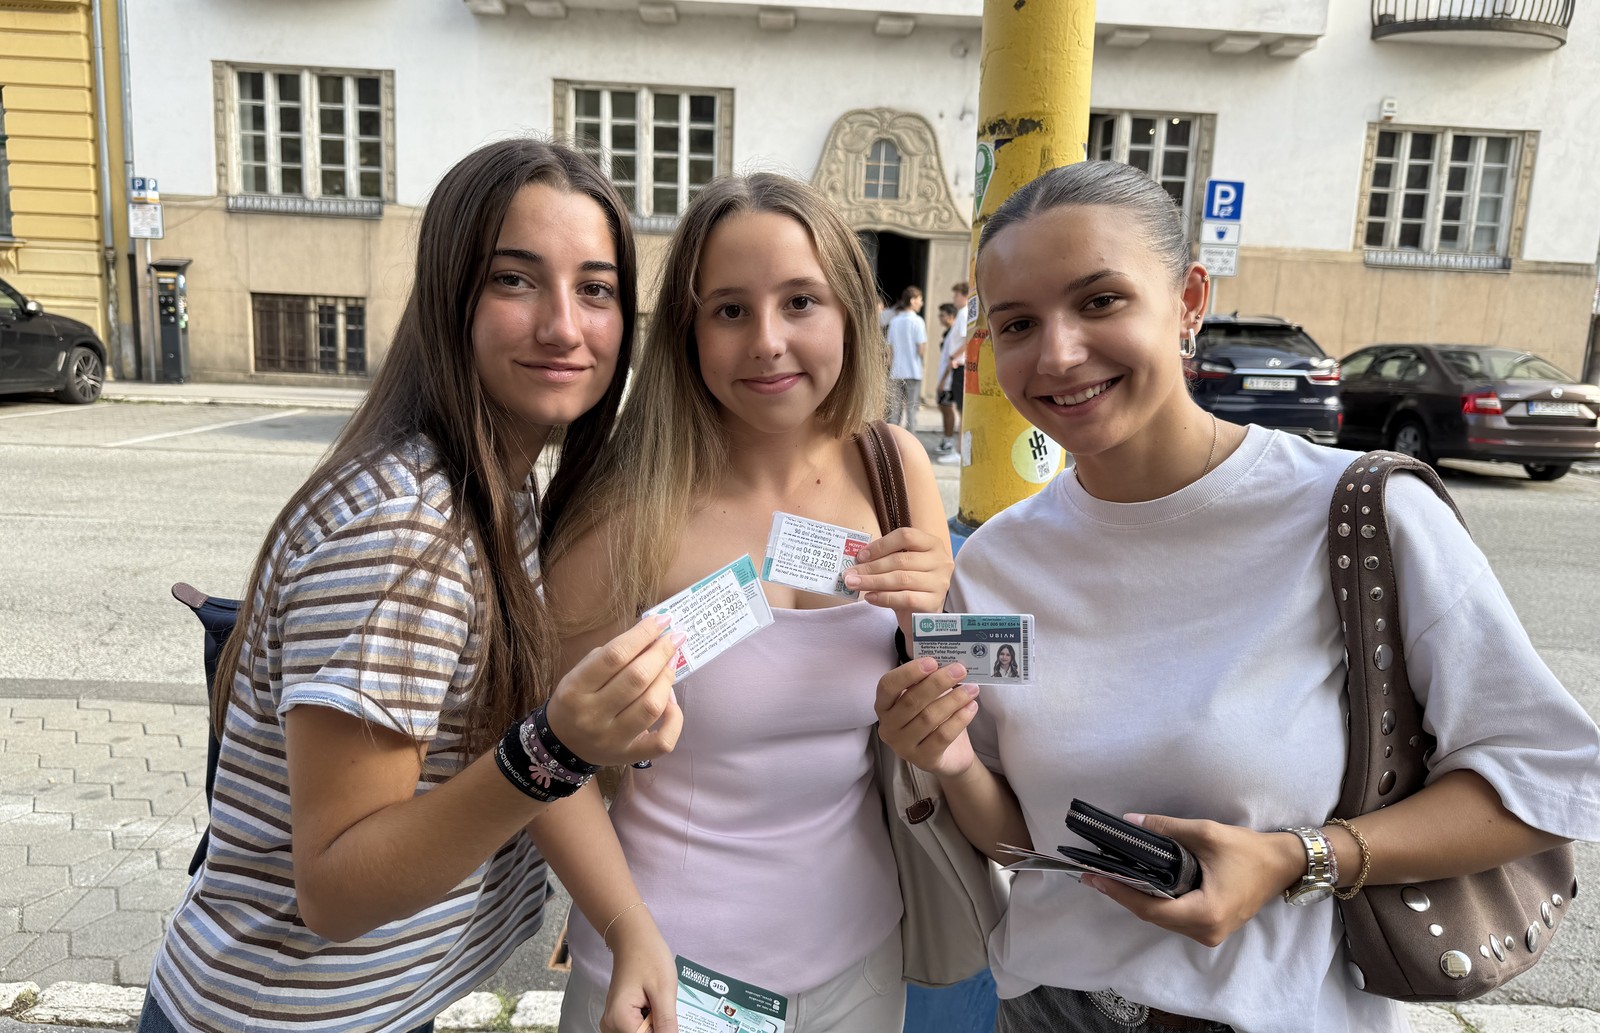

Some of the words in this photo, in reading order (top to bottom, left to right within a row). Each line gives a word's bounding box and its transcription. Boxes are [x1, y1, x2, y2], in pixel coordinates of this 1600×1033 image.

[1212, 183, 1237, 217] P
[682, 969, 710, 985] STUDENT
[712, 981, 727, 992] ISIC
